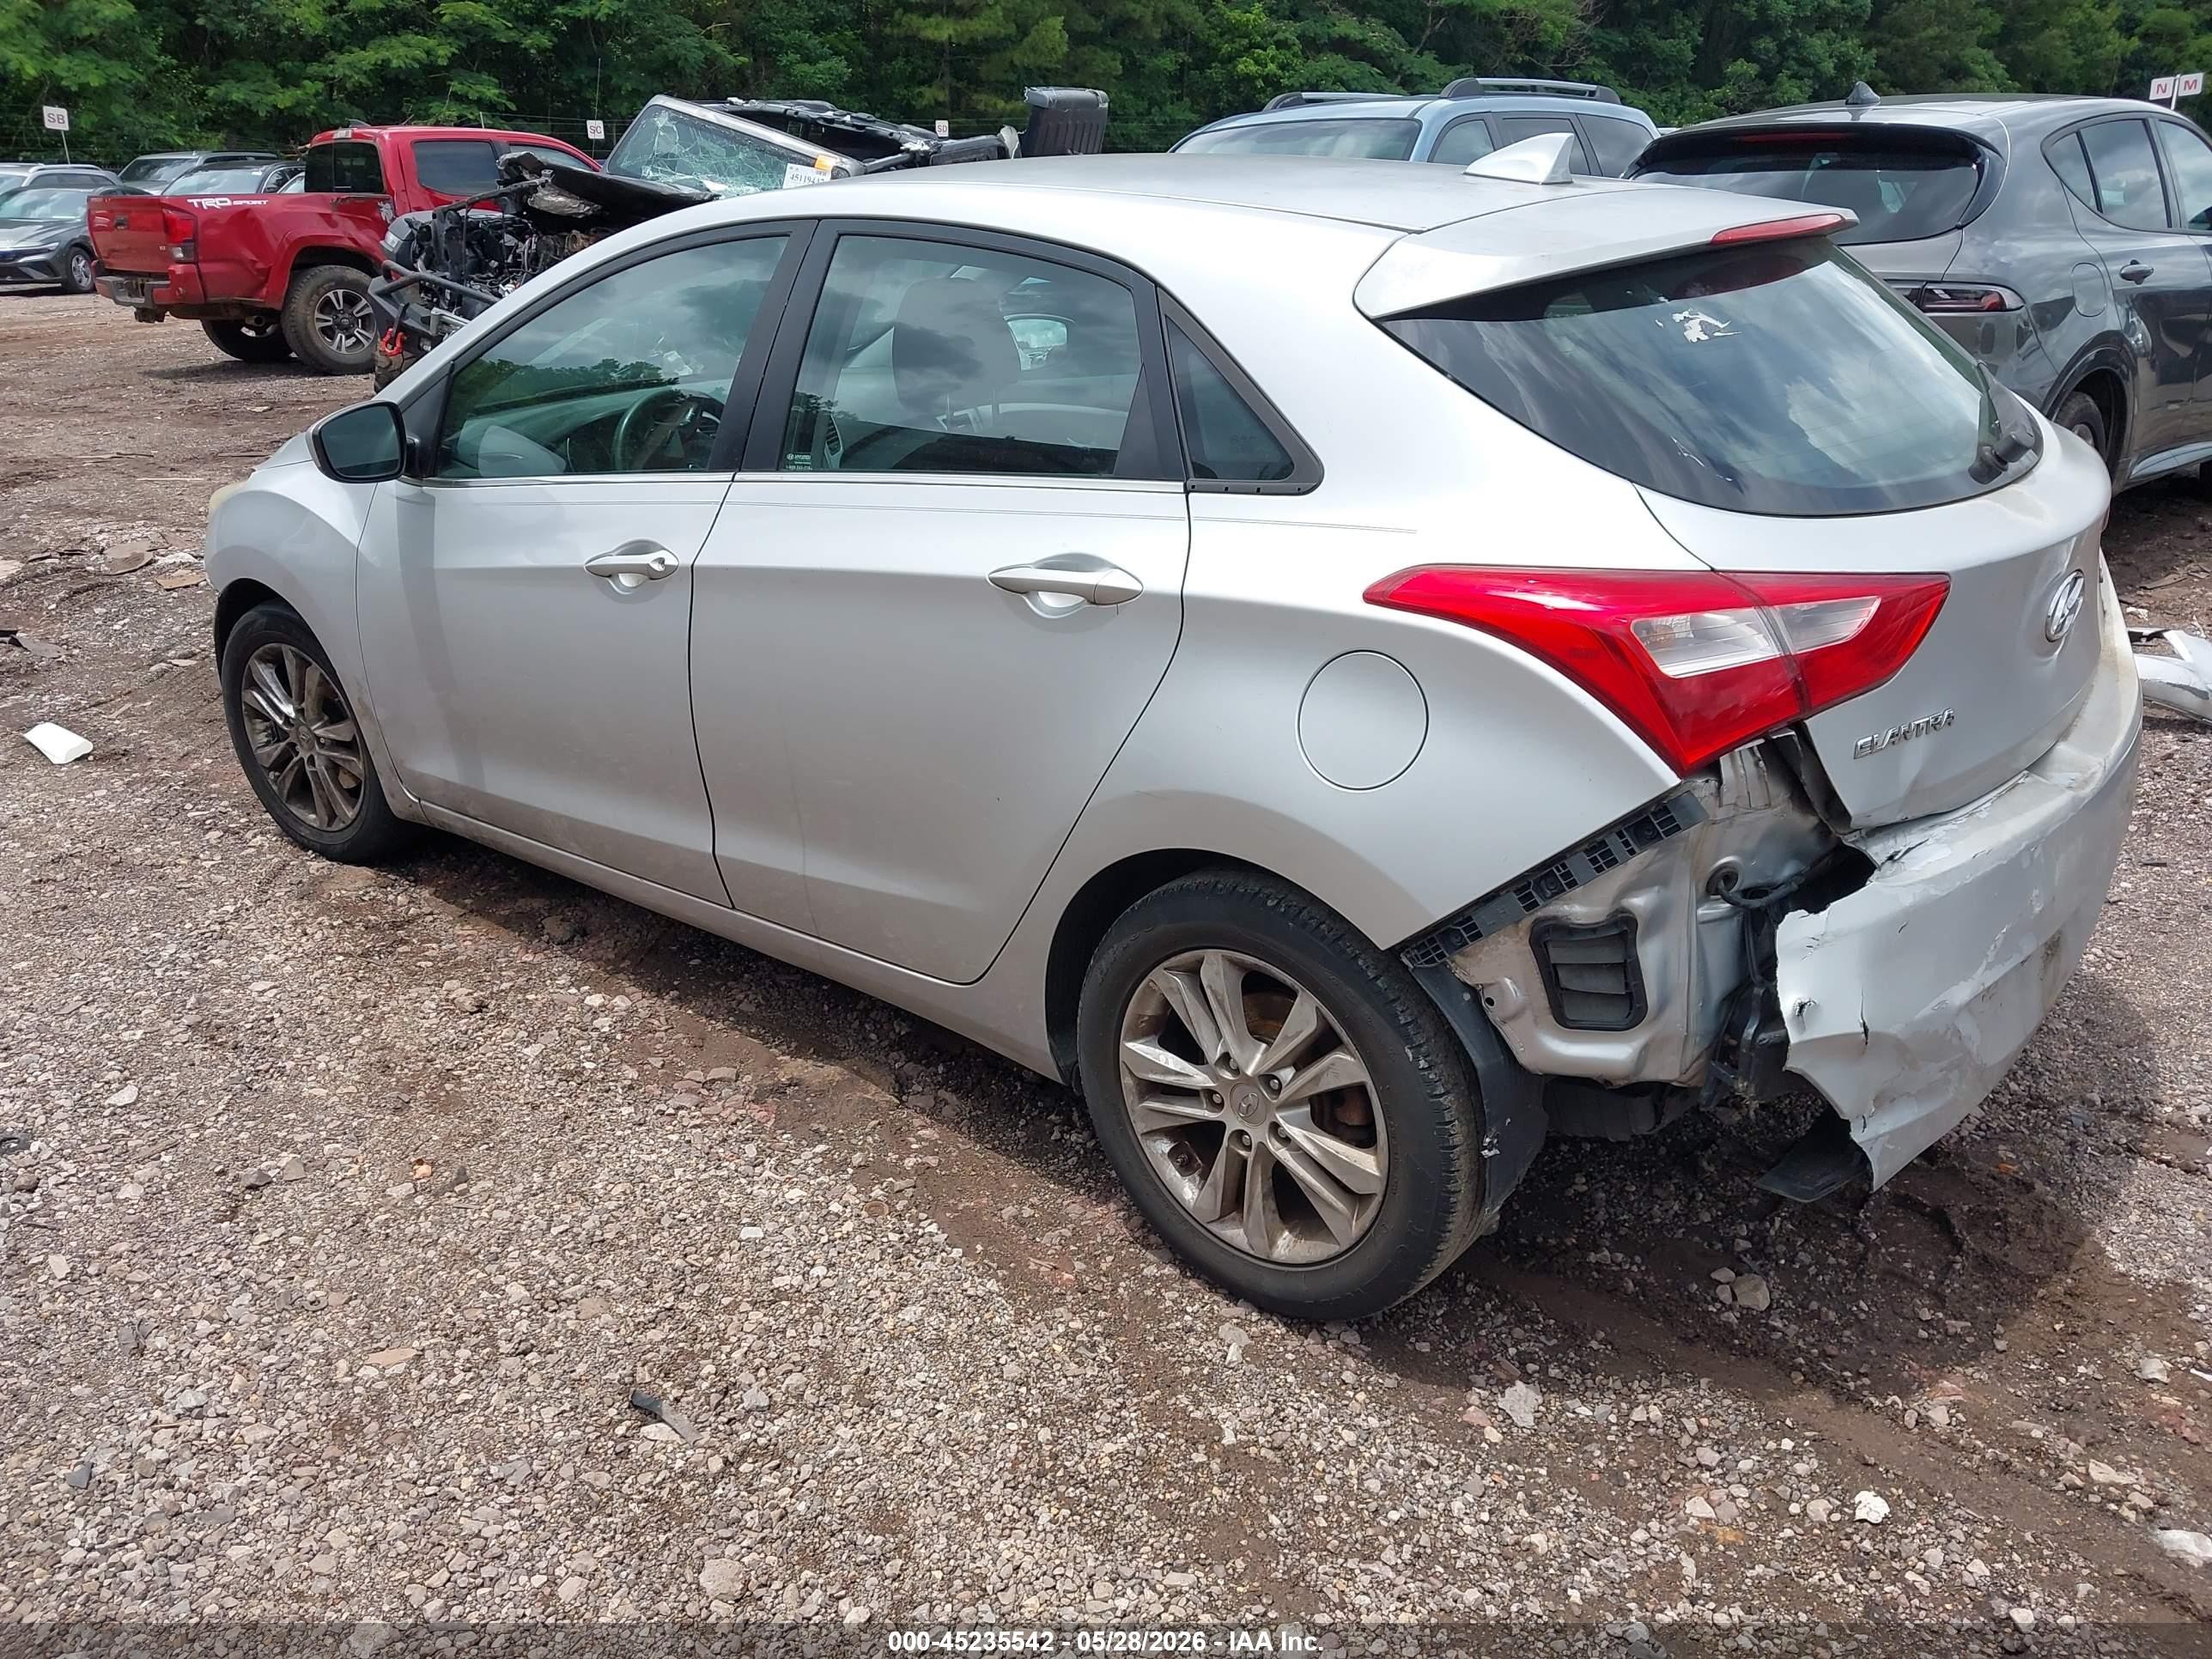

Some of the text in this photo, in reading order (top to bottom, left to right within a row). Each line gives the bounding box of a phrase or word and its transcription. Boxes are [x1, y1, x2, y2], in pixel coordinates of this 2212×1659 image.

[2156, 82, 2167, 94] N
[2184, 79, 2198, 91] M
[47, 112, 65, 124] SB
[589, 125, 602, 134] SC
[186, 197, 232, 210] TRD
[1853, 708, 1954, 760] ELANTRA
